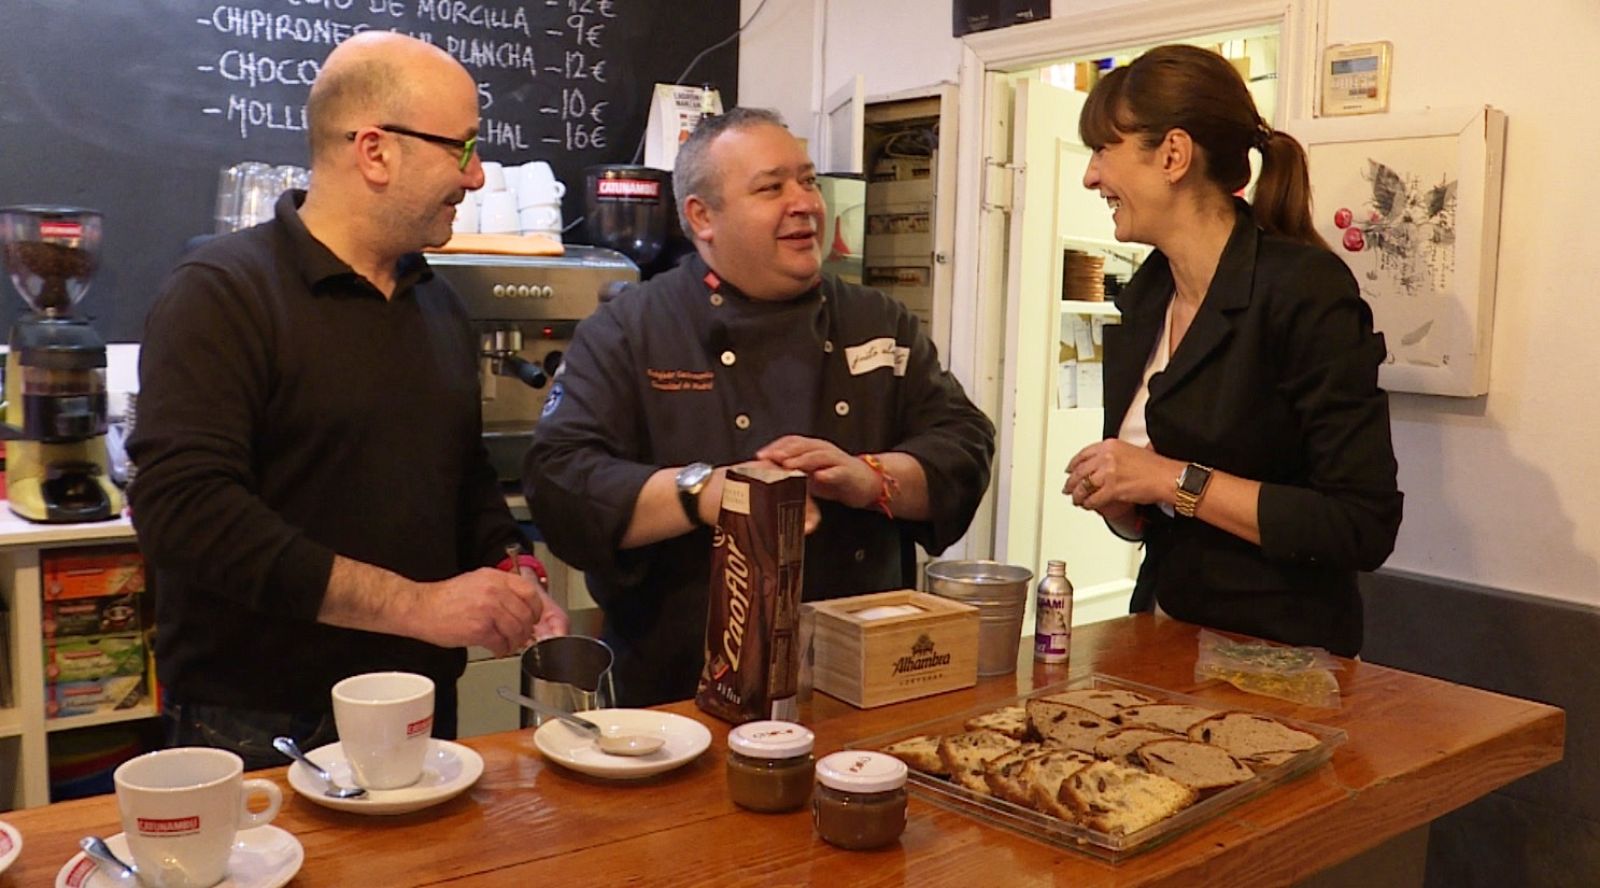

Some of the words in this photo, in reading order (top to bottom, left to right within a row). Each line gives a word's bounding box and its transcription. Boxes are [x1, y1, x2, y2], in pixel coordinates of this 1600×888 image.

[417, 0, 531, 37] MORCILLA
[447, 35, 537, 76] PLANCHA
[891, 651, 951, 677] Alhambra
